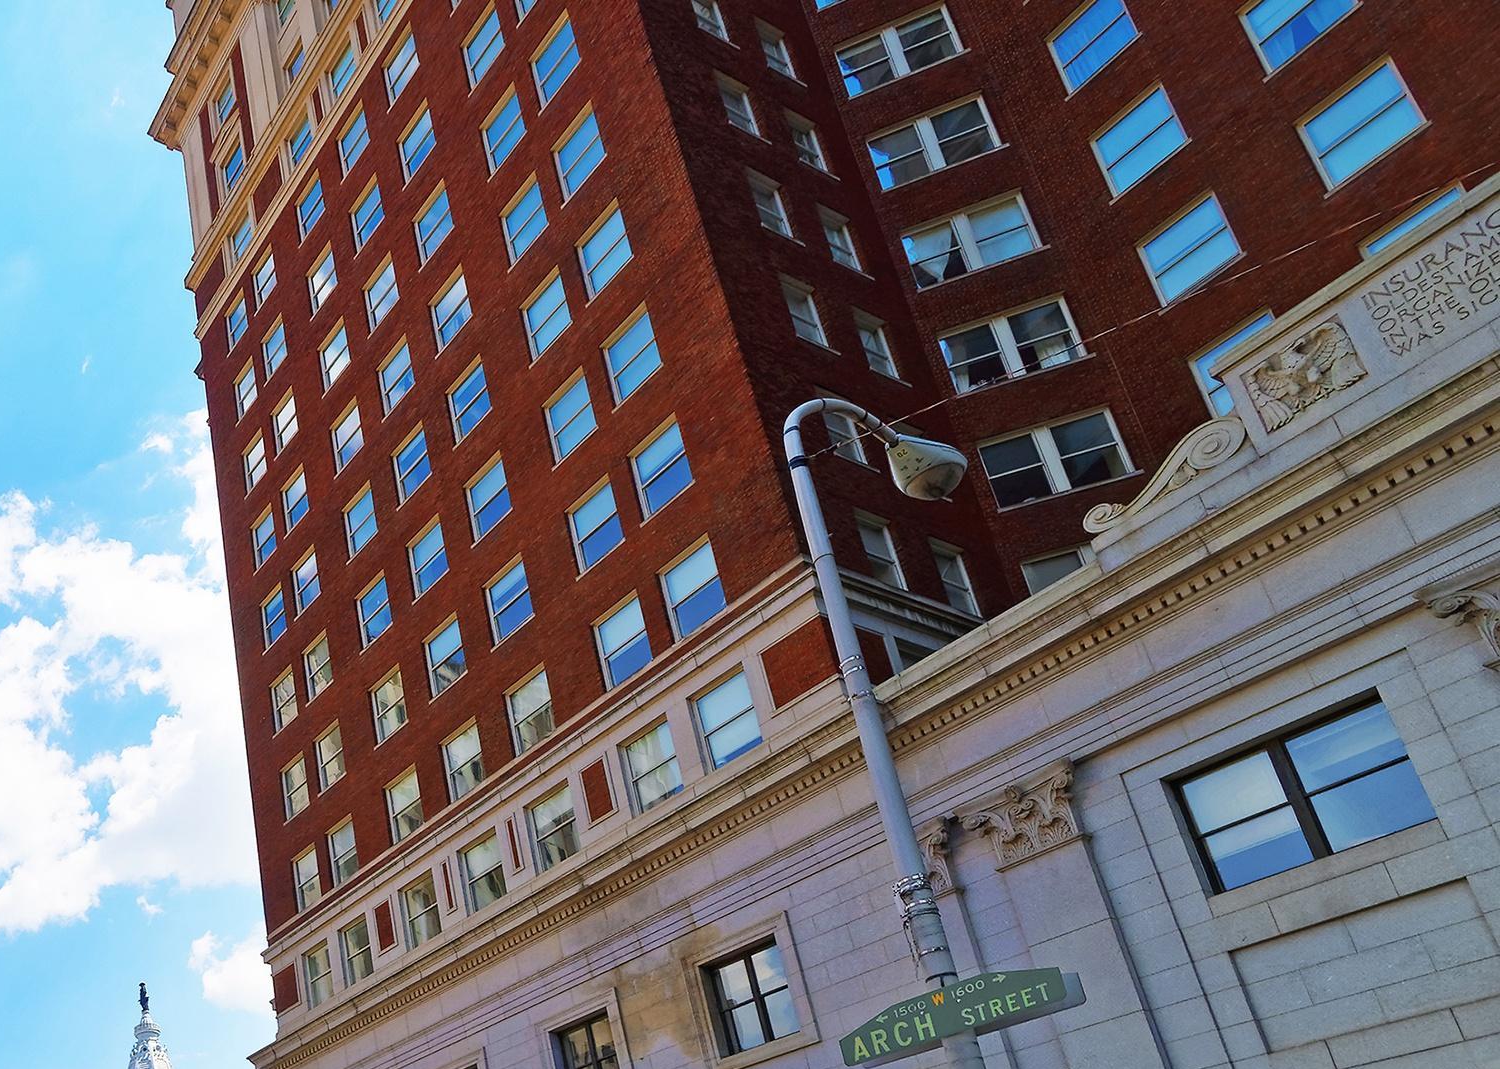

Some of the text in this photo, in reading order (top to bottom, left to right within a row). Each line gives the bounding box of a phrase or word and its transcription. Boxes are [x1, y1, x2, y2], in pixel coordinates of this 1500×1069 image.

[1371, 231, 1500, 320] OLDEST AM
[1378, 250, 1500, 333] ORGANIZE
[1383, 326, 1407, 347] IN
[1410, 295, 1461, 329] THE
[1390, 284, 1500, 357] WAS SIG
[853, 982, 1049, 1062] ARCH STREET
[893, 979, 986, 1019] 1500 W 1600
